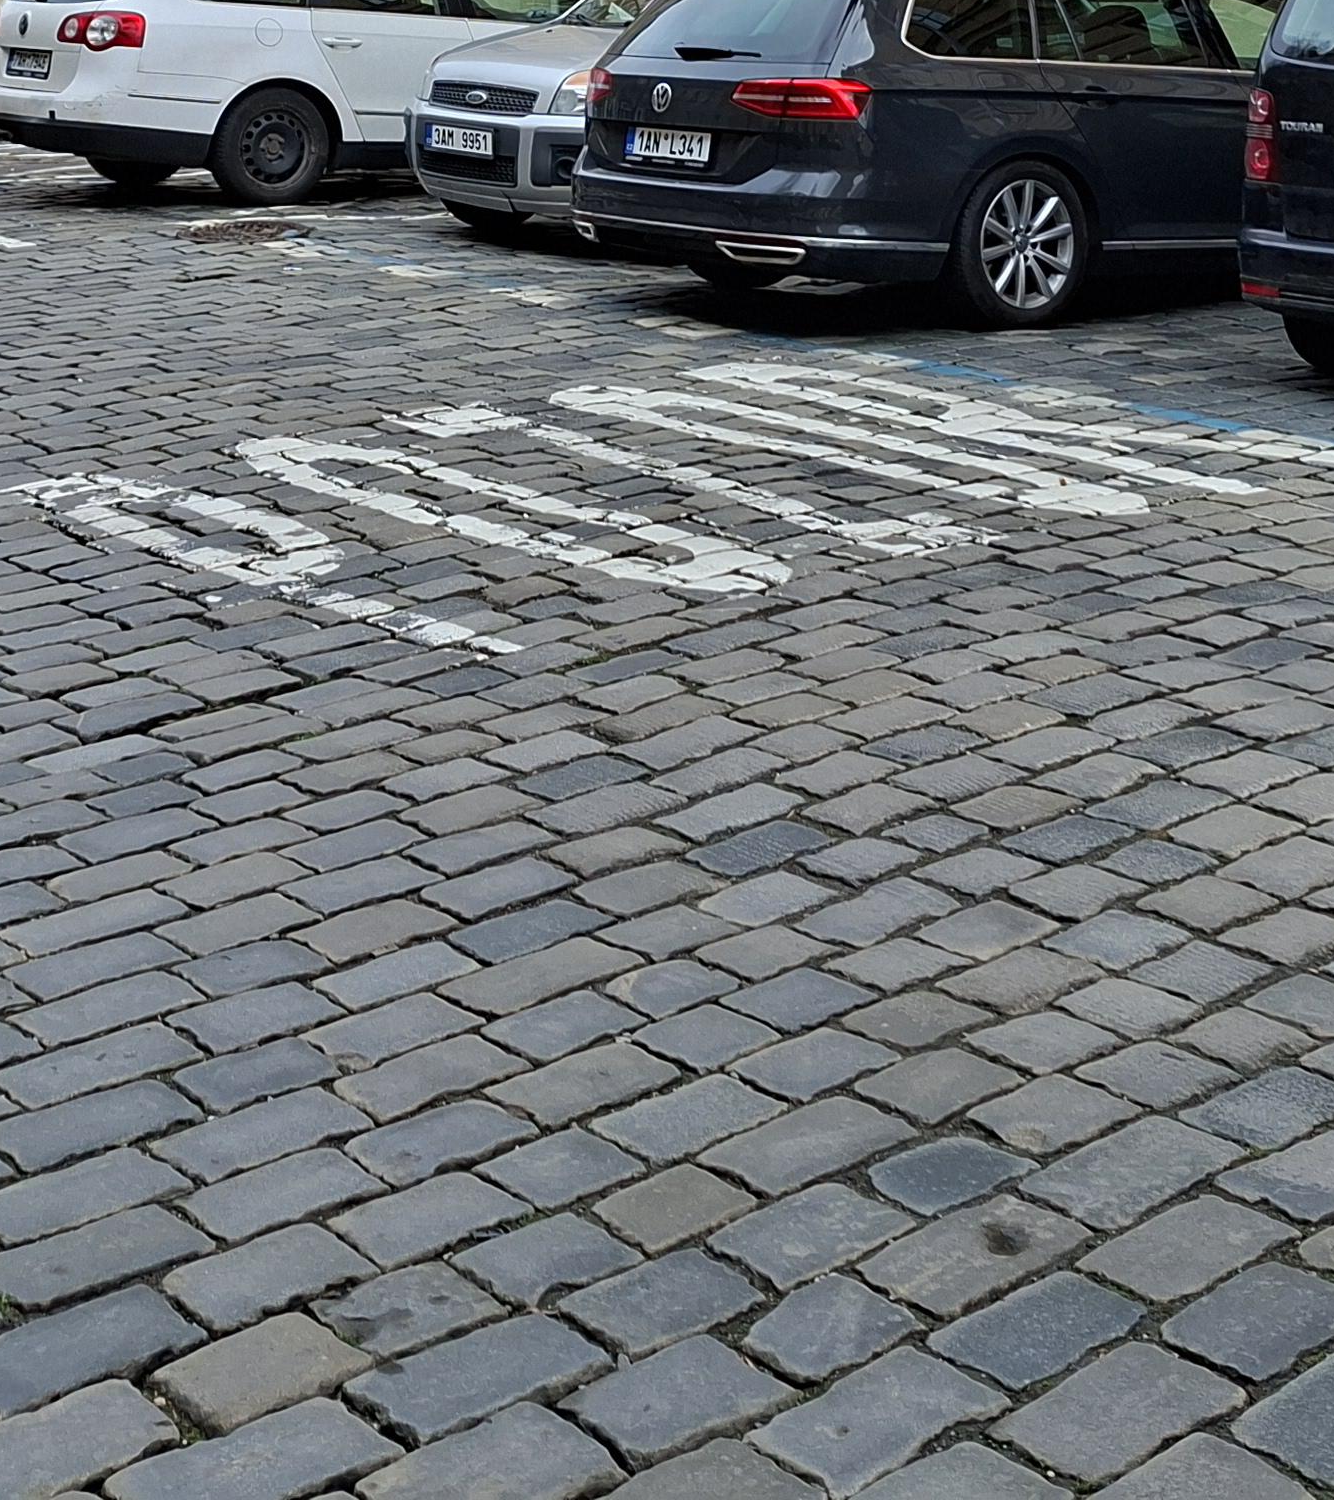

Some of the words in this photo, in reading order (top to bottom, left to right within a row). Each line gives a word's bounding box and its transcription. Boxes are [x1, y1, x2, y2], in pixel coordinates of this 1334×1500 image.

[434, 128, 454, 147] 3AM
[462, 131, 488, 151] 9951
[638, 130, 662, 153] 1AN
[669, 132, 704, 157] L341
